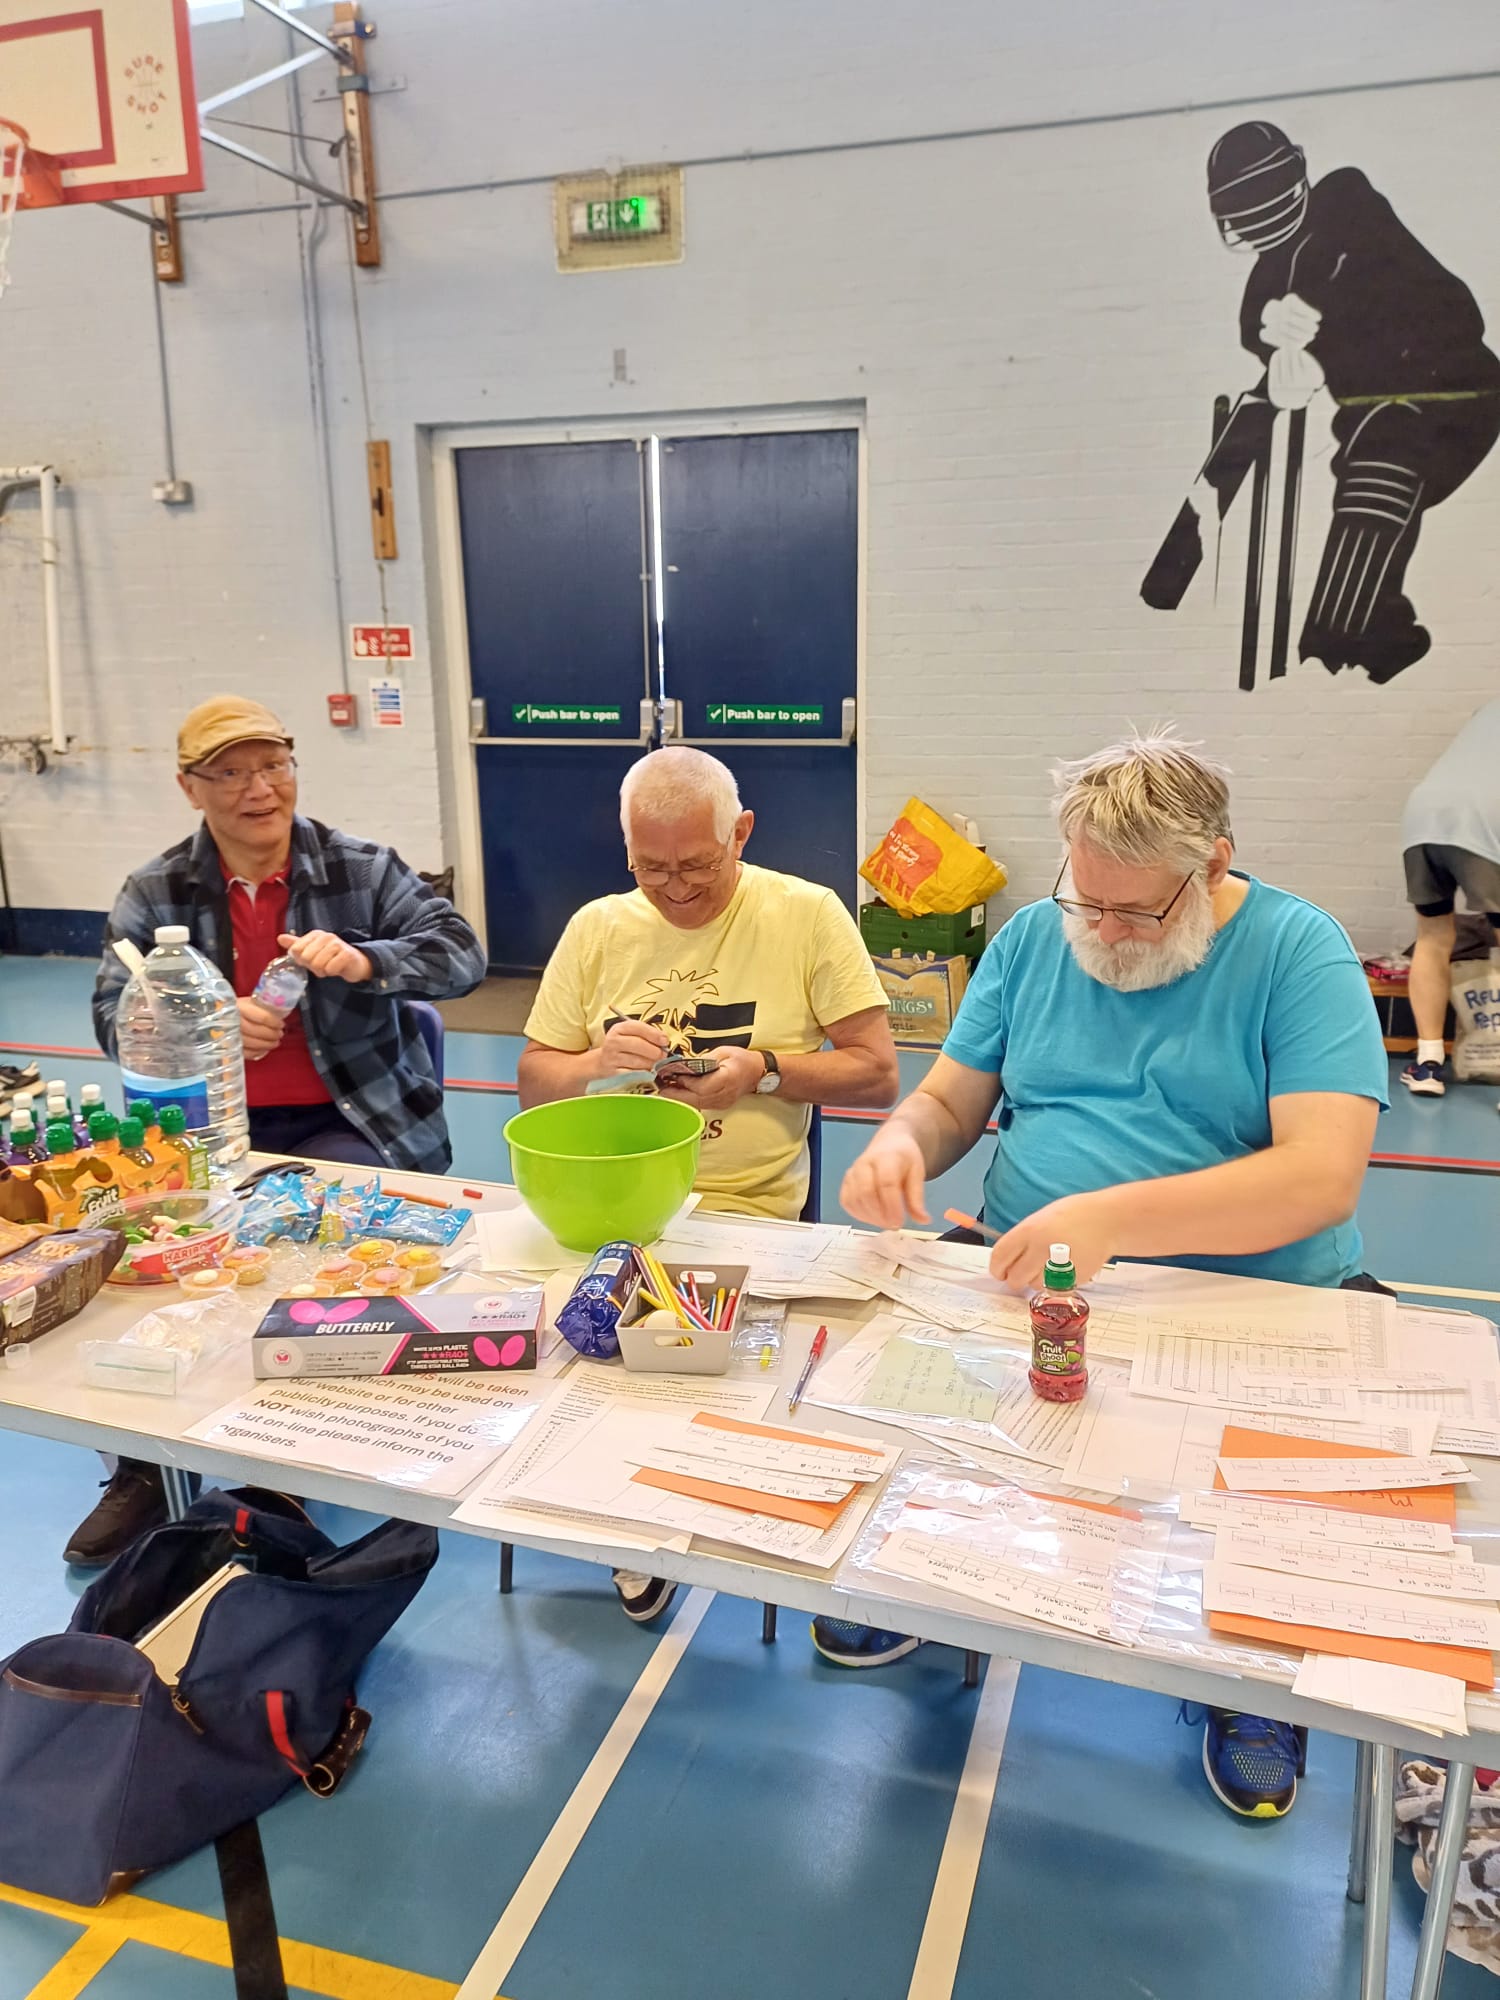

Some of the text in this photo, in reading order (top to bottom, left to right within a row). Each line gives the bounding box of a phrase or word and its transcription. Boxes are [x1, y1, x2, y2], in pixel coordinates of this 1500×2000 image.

[531, 709, 619, 722] Push bar to open
[727, 709, 820, 723] Push bar to open
[88, 1187, 118, 1214] Fruit
[315, 1321, 395, 1334] BUTTERFLY
[1040, 1353, 1066, 1362] Shoot
[1042, 1344, 1061, 1354] Fruit
[288, 1377, 459, 1414] our website or for other
[396, 1383, 430, 1395] may
[430, 1389, 451, 1399] be
[452, 1393, 493, 1406] used
[493, 1400, 514, 1409] on
[438, 1376, 464, 1386] will
[465, 1380, 485, 1390] be
[486, 1383, 529, 1397] taken
[269, 1388, 478, 1435] publicity purposes. If you do
[218, 1424, 297, 1448] organisers.
[254, 1399, 475, 1451] NOT wish photographs of you
[263, 1417, 317, 1434] on-line
[315, 1428, 371, 1447] please
[371, 1438, 424, 1457] inform
[427, 1451, 454, 1463] the
